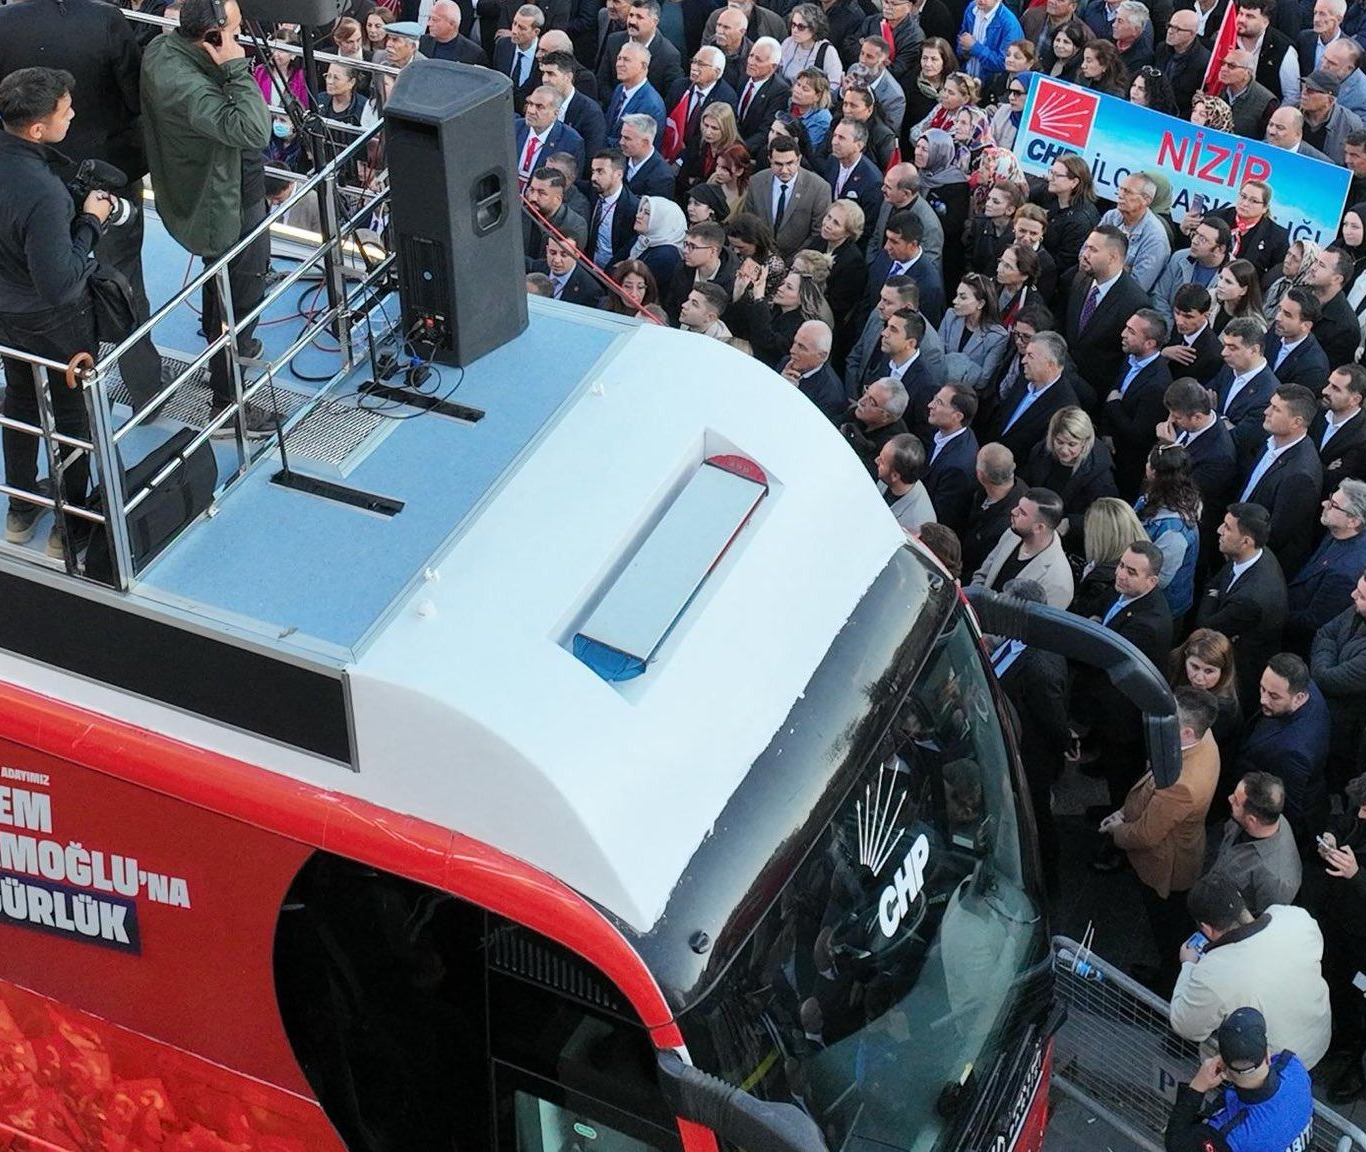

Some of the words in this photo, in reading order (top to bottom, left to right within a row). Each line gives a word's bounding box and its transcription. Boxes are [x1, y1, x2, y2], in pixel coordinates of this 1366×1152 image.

[1092, 152, 1131, 197] İLÇ
[1156, 129, 1274, 187] NİZİP
[0, 765, 51, 788] ADAYIMIZ
[878, 833, 930, 938] CHP
